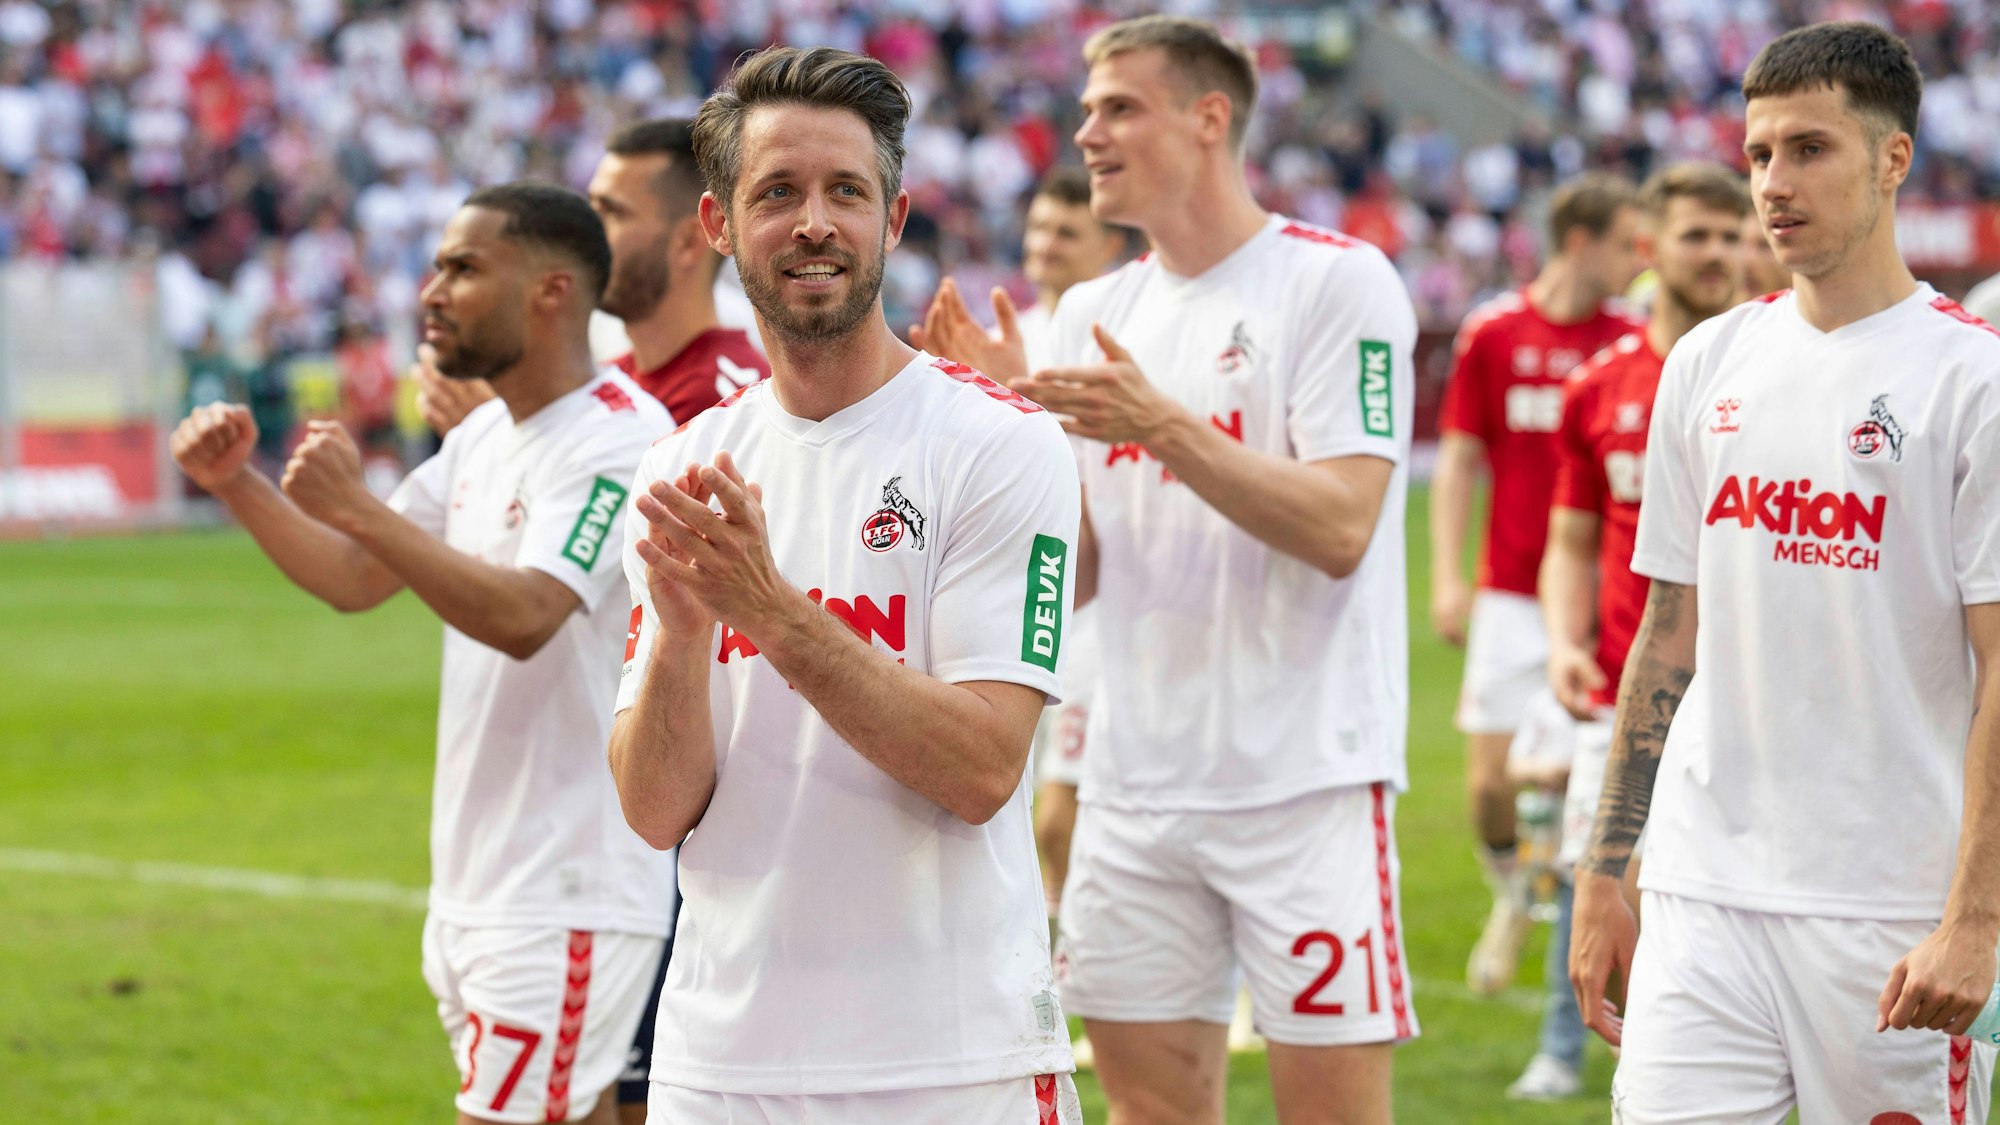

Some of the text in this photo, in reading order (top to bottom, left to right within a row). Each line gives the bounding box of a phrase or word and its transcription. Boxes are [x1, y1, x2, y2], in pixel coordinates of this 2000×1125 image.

[1363, 349, 1390, 432] DEVK
[570, 487, 621, 563] DEVK
[880, 524, 896, 536] FC
[1773, 539, 1879, 572] MENSCH
[1032, 550, 1062, 659] DEVK
[1291, 928, 1380, 1015] 21
